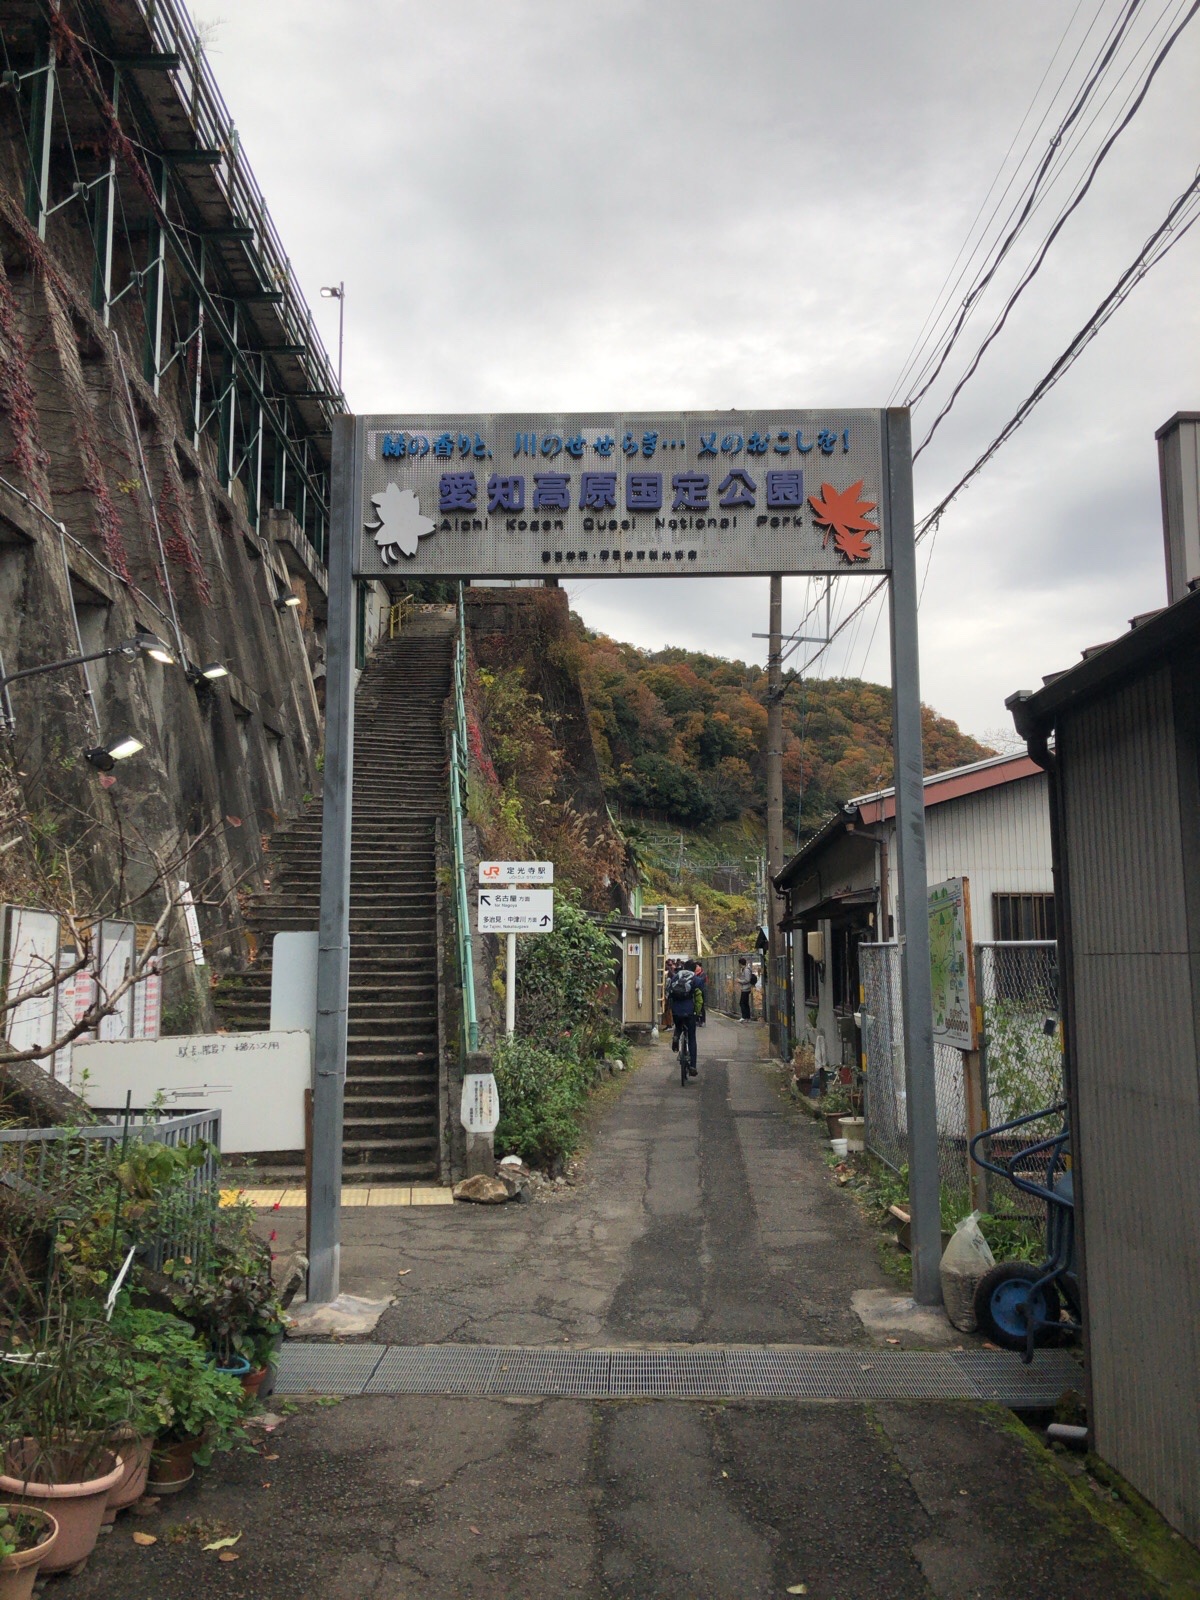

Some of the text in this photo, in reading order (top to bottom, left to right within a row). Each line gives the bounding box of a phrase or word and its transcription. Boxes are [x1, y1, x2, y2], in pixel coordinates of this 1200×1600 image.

[382, 431, 493, 457] 緑の香りと、
[438, 469, 803, 513] 愛知高原国定公園
[440, 517, 489, 531] Aichi
[583, 517, 636, 531] Quasi
[654, 516, 738, 529] National
[756, 515, 803, 528] Park
[484, 867, 499, 876] JR
[507, 867, 545, 875] 定光寺駅
